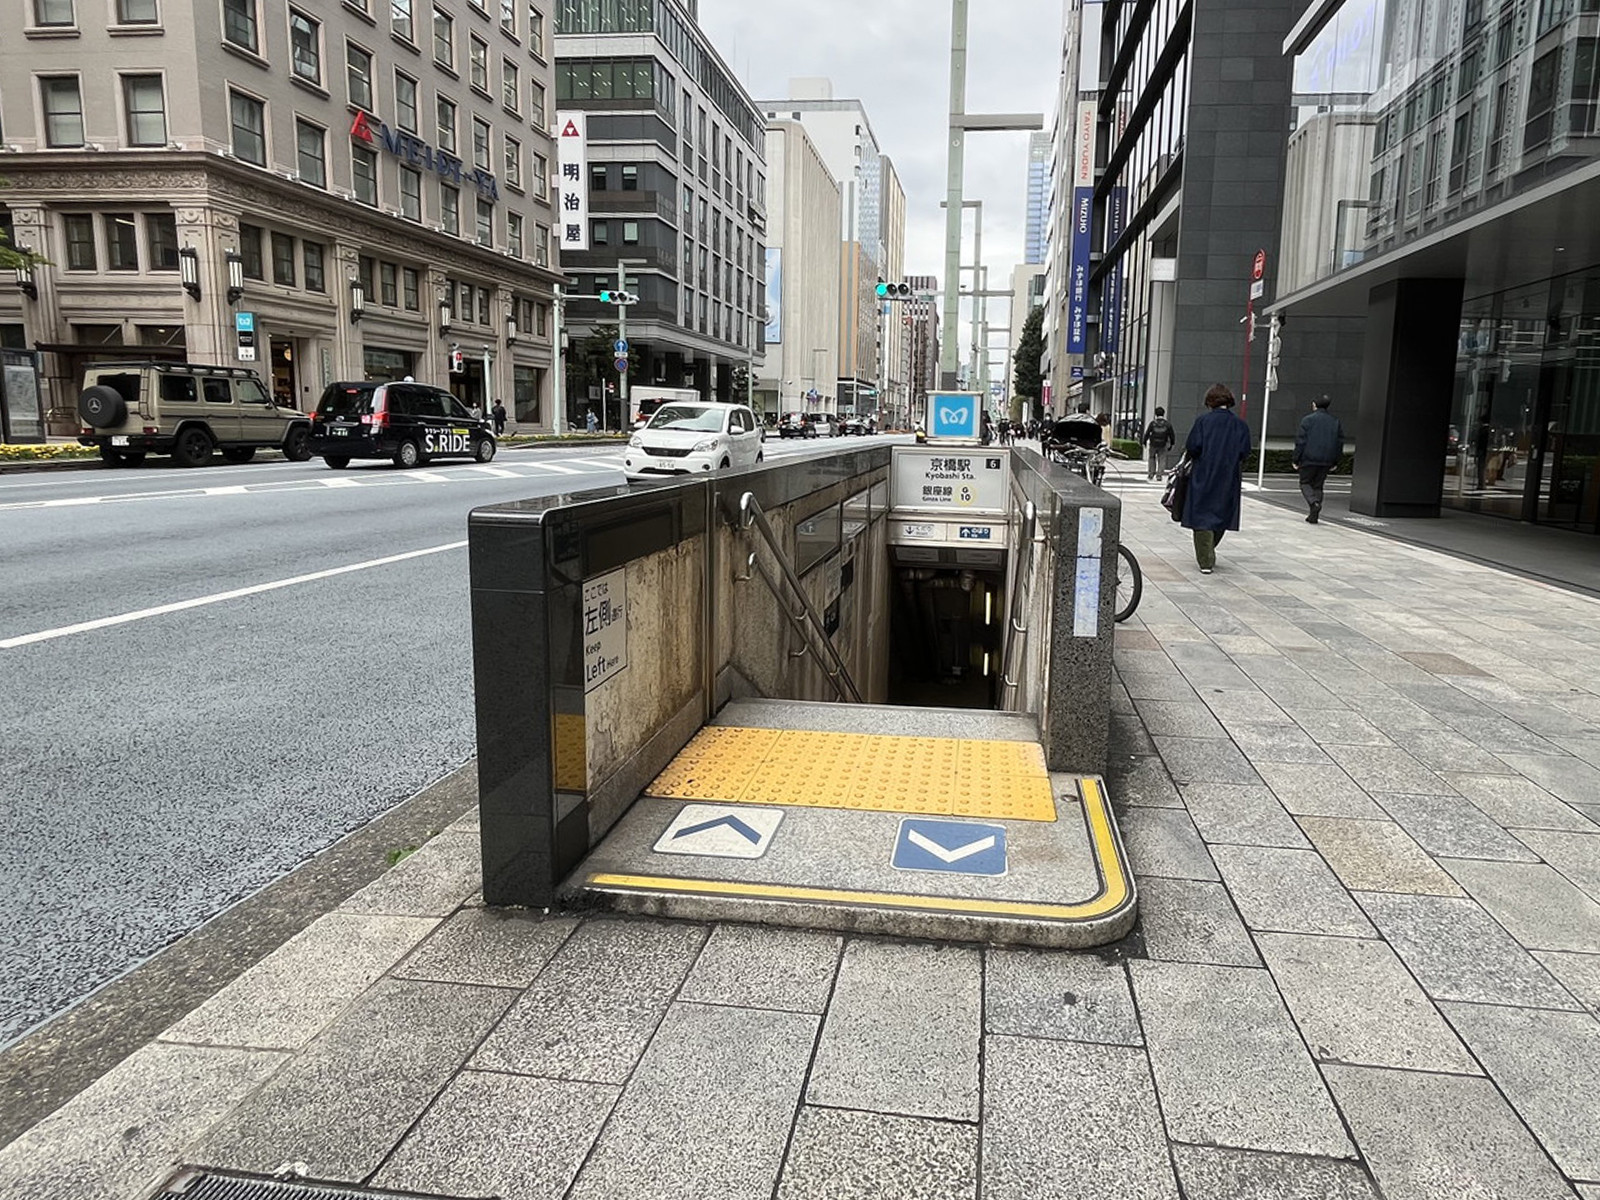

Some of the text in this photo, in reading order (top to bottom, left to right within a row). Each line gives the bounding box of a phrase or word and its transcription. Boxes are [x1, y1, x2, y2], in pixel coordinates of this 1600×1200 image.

[1081, 110, 1091, 180] TAIYO YUDEN
[563, 163, 581, 241] 明治屋
[1079, 197, 1089, 234] MIZUHO
[425, 434, 471, 453] S.RIDE
[930, 457, 971, 472] 京橋駅
[925, 472, 976, 481] Kyobashi Sta.
[922, 485, 953, 496] 銀座線
[960, 493, 971, 501] 10
[585, 582, 608, 602] ここでは
[586, 641, 601, 656] Keep
[586, 655, 606, 682] Left
